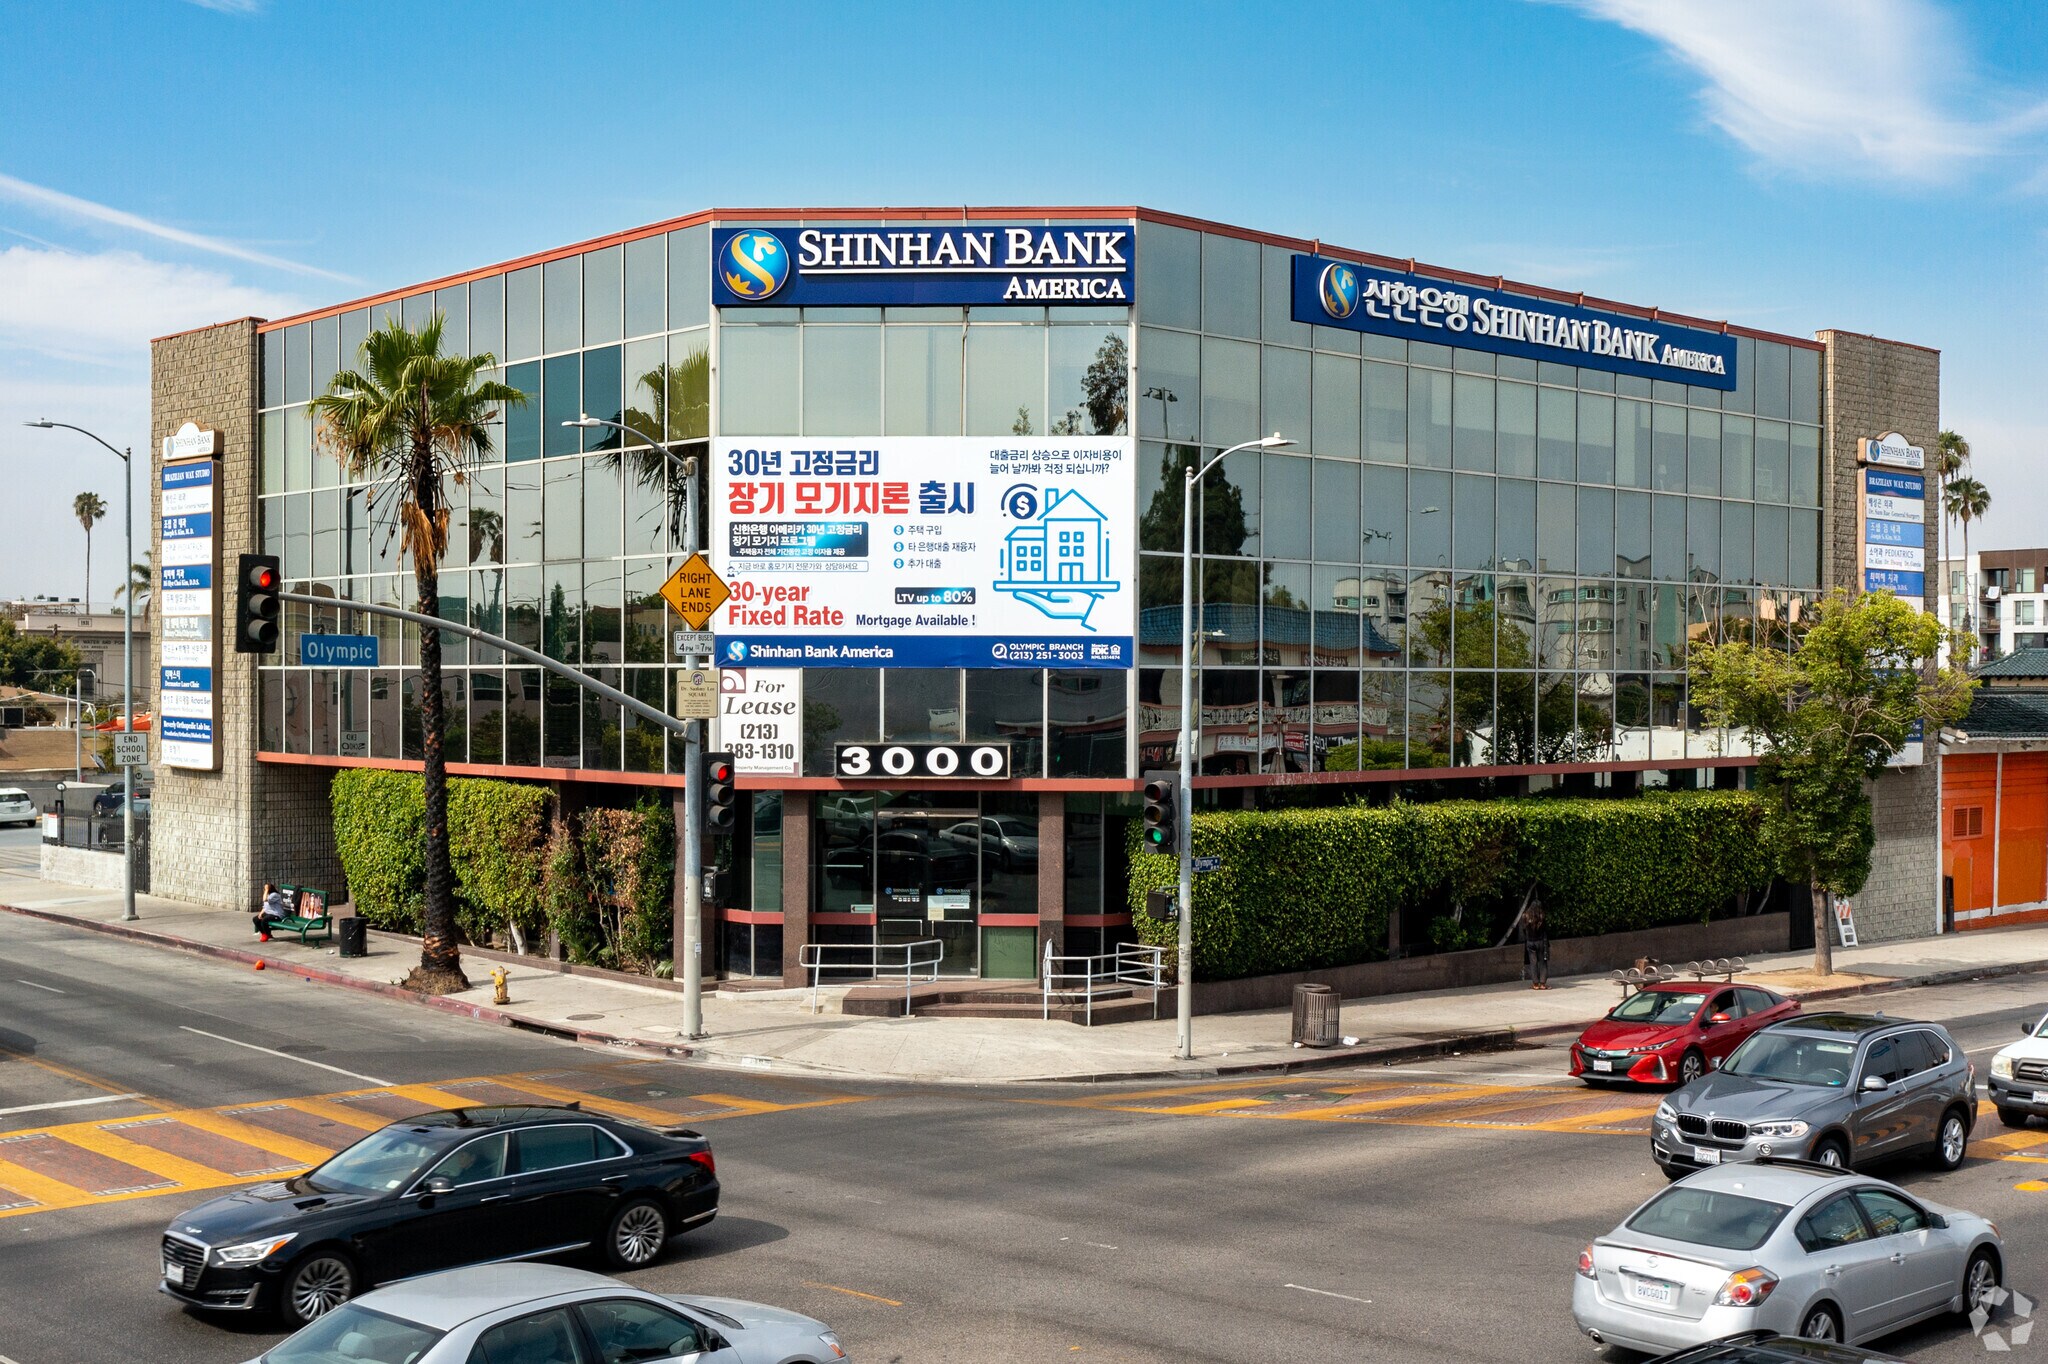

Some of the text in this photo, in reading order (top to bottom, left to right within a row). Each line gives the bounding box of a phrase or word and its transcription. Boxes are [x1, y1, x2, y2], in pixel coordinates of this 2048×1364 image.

[798, 229, 1126, 266] SHINHAN BANK
[1003, 276, 1126, 300] AMERICA
[1363, 278, 1726, 375] 신한은행 SHINHAN BANK AMERICA
[990, 450, 1122, 461] 대출금리 상승으로 이자비용이
[1881, 445, 1920, 458] SHINHAN BANK
[728, 449, 879, 476] 30년 고정금리
[990, 463, 1110, 474] 늘어 날까봐 걱정 되십니까?
[165, 468, 210, 481] BRAZILIAN WAX STUDIO
[1869, 477, 1921, 490] BRAZILIAN WAX STUDIO
[728, 481, 974, 514] 장기 모기지론 출시
[732, 524, 862, 535] 신한은행 아메리카 30년 고정금리
[908, 526, 942, 535] 주택 구입
[732, 536, 816, 546] 장기 모기지 프로그램
[908, 542, 976, 552] 타 은행대출 재융자
[1885, 549, 1914, 558] PEDIATRICS
[738, 562, 858, 571] 지금 바로 홈모기지 전문가와 상담하세요
[908, 558, 942, 568] 추가 대출
[680, 573, 712, 584] RIGHT
[681, 588, 711, 598] LANE
[729, 581, 810, 606] 30-year
[896, 594, 914, 602] LTV
[916, 595, 929, 604] up
[943, 590, 973, 602] 80%
[682, 602, 712, 612] ENDS
[729, 605, 844, 626] Fixed Rate
[856, 614, 912, 628] Mortgage
[915, 614, 968, 626] Available
[308, 642, 372, 662] Olympic
[679, 643, 712, 652] 4PM 7PM
[750, 645, 893, 658] Shinhan Bank America
[1009, 652, 1033, 660] (213)
[754, 680, 785, 693] For
[723, 696, 796, 715] Lease
[741, 724, 778, 739] (213)
[725, 743, 794, 759] 383-1310
[841, 746, 1003, 776] 3000
